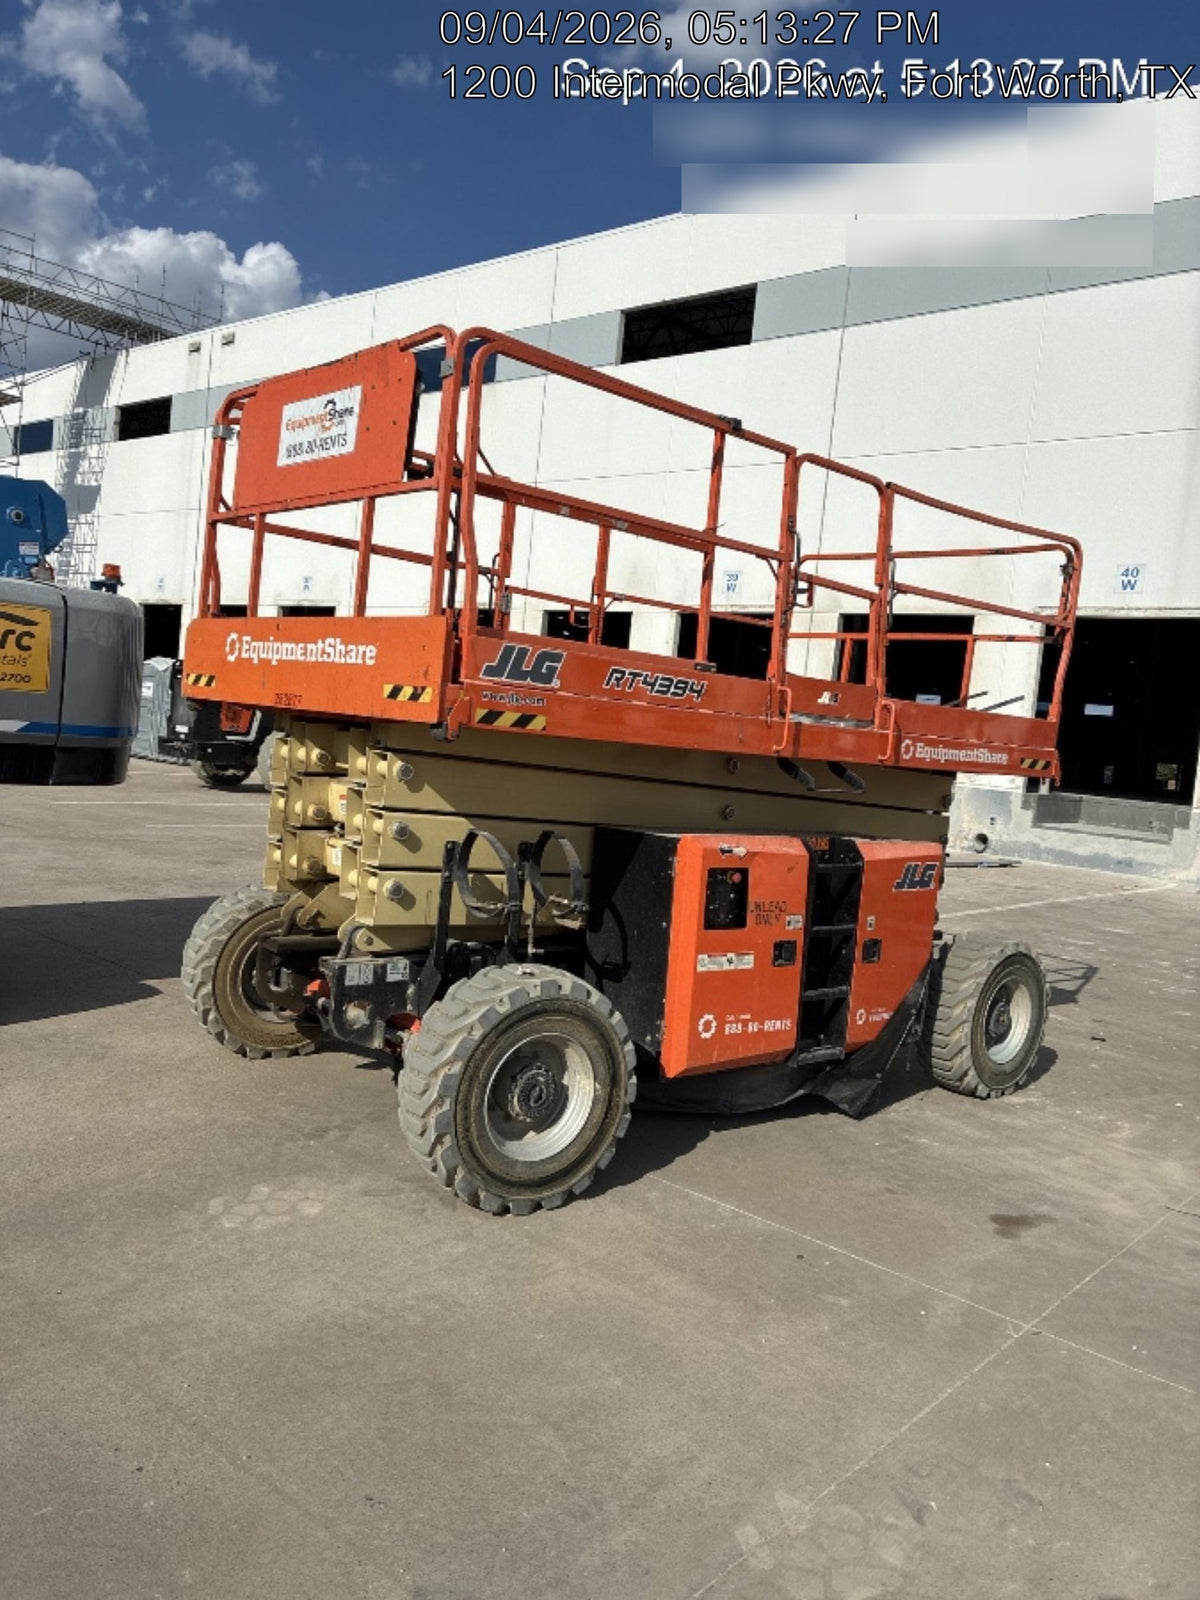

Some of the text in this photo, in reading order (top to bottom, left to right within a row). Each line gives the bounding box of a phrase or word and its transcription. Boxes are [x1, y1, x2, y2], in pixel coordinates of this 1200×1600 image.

[1120, 566, 1140, 578] 40
[1121, 579, 1138, 591] W
[241, 635, 377, 665] EquipmentShare
[480, 643, 567, 688] JLG
[603, 666, 708, 701] RT4394
[915, 743, 1009, 765] EquipmentShare
[893, 862, 939, 892] JLG
